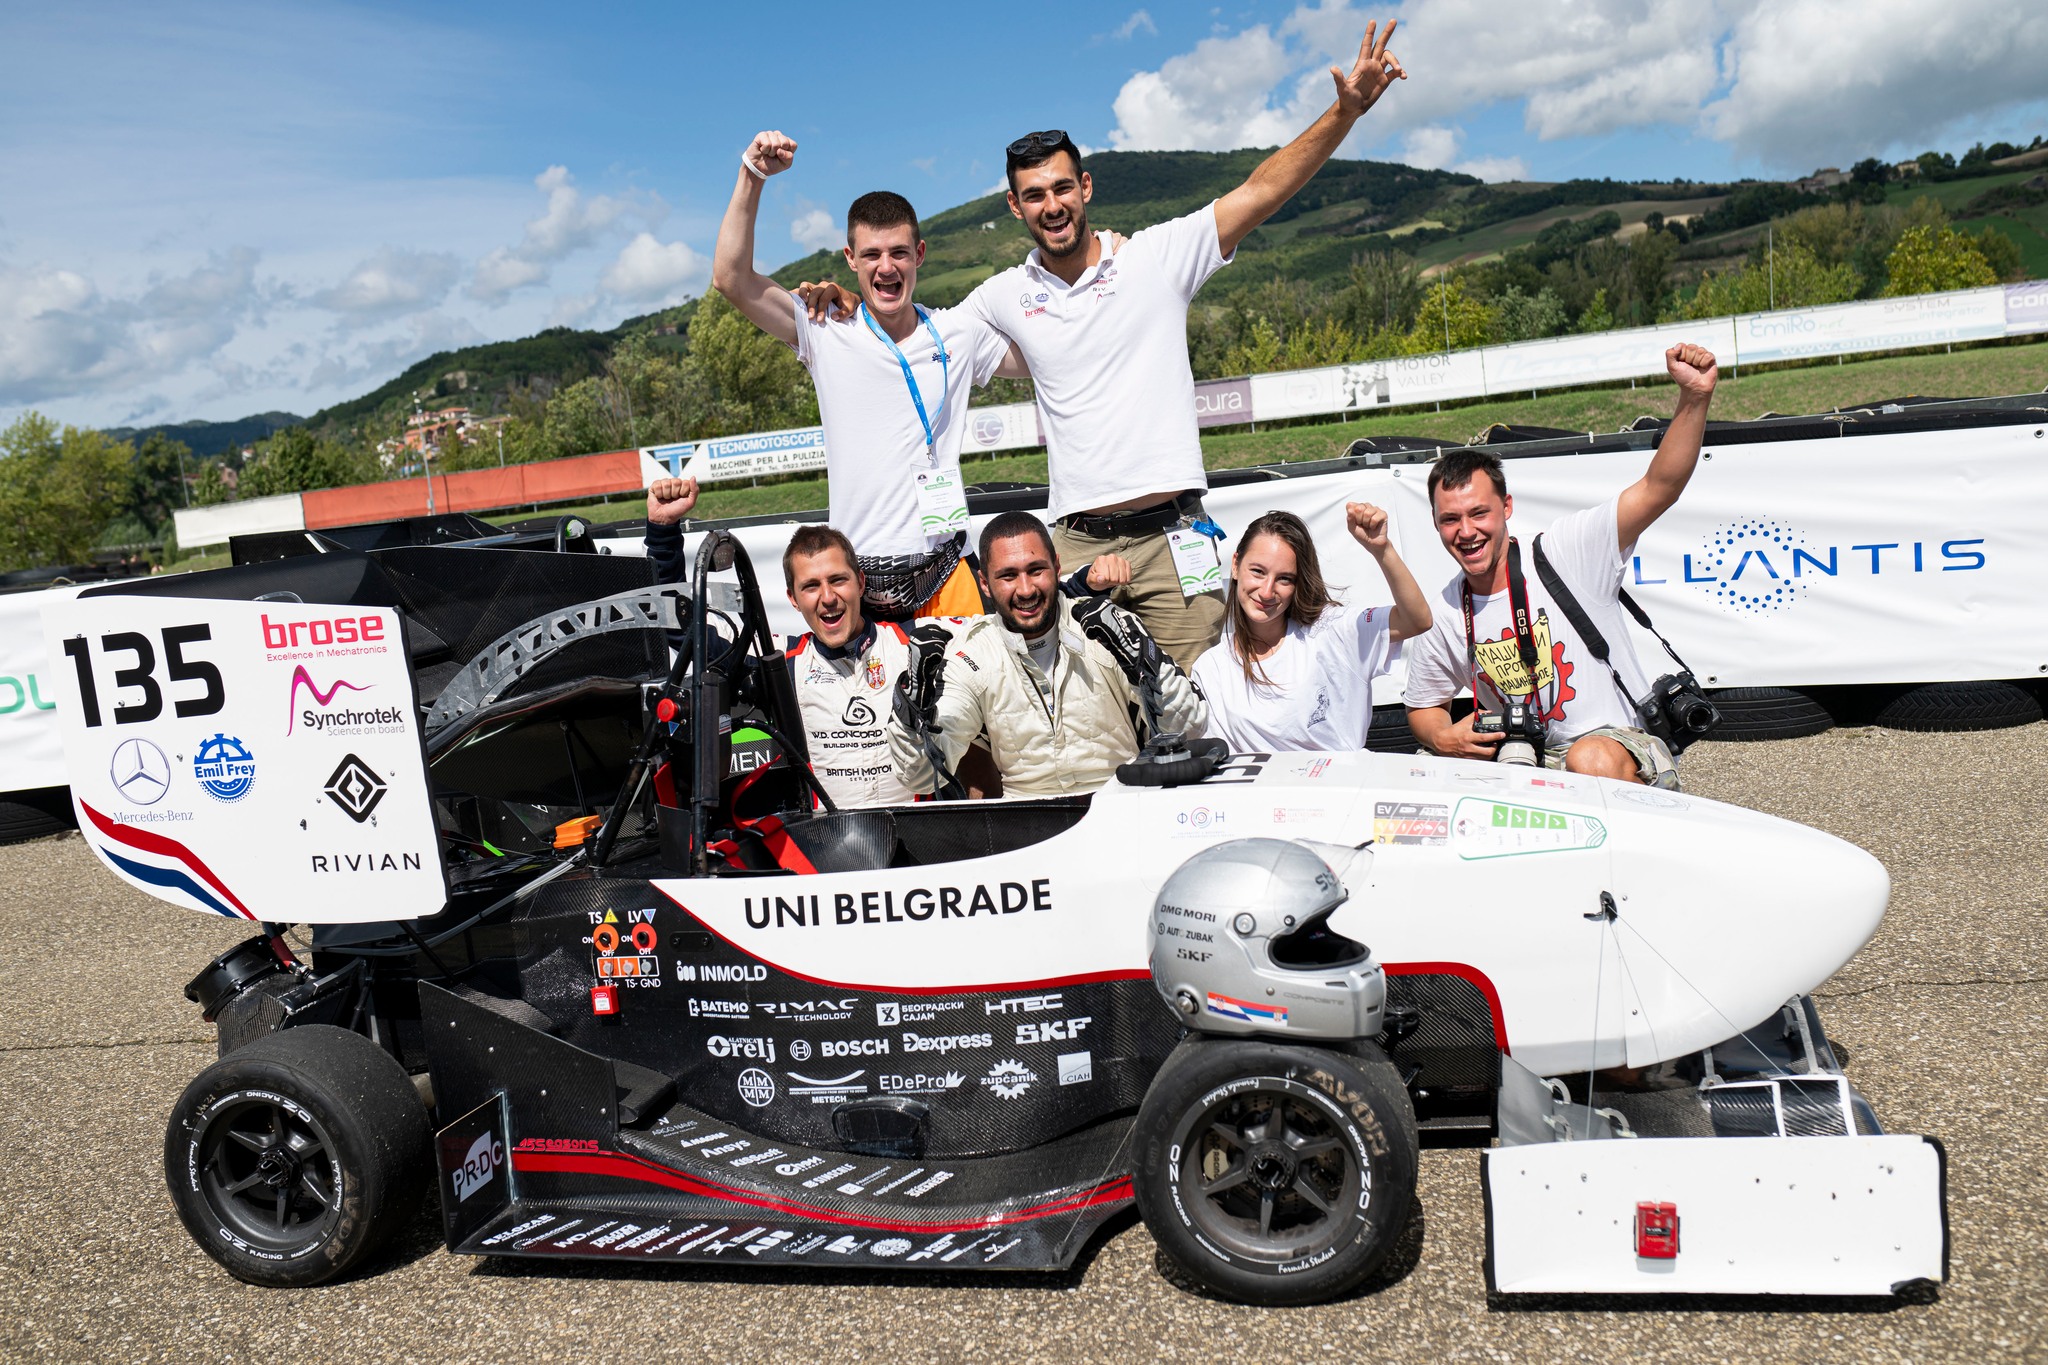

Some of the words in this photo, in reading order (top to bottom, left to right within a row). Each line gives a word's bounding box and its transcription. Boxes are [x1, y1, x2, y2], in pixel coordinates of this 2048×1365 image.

[1395, 354, 1451, 372] MOTOR
[1398, 373, 1446, 388] VALLEY
[1194, 391, 1242, 413] cura
[709, 431, 824, 458] TECNOMOTOSCOPE
[710, 459, 753, 471] MACCHINE
[756, 456, 773, 465] PER
[777, 454, 788, 463] LA
[792, 450, 826, 461] PULIZIA
[1632, 538, 1986, 585] LLANTIS
[1516, 608, 1528, 635] EOS
[261, 613, 385, 649] brose
[267, 651, 314, 663] Excellence
[316, 649, 325, 659] in
[327, 645, 388, 658] Mechatronics
[63, 622, 226, 728] 135
[303, 706, 404, 731] Synchrotek
[327, 725, 362, 736] Science
[364, 726, 376, 736] on
[377, 723, 405, 735] board
[831, 729, 883, 739] CONCORD
[861, 739, 888, 749] COMPA
[195, 764, 224, 780] Emil
[226, 761, 256, 780] Frey
[826, 767, 860, 777] BRITISH
[113, 809, 195, 825] Mercedes-Benz
[1377, 805, 1393, 815] EV
[311, 853, 422, 873] RIVIAN
[744, 897, 820, 929] UNI
[835, 878, 1053, 925] BELGRADE
[588, 911, 604, 925] TS
[627, 910, 643, 924] LV
[1160, 904, 1182, 916] DMG
[1183, 909, 1217, 923] MORI
[582, 936, 594, 944] ON
[621, 935, 633, 943] ON
[1186, 930, 1214, 944] ZUBAK
[1177, 948, 1214, 963] SKF
[700, 965, 768, 982] INMOLD
[640, 978, 662, 988] GND
[700, 1000, 749, 1014] BATEMO
[755, 998, 859, 1014] RIMAC
[901, 1001, 965, 1013] БЕОГРАДСКИ
[985, 993, 1064, 1016] HTEC
[793, 1012, 852, 1022] TECHNOLOGY
[902, 1012, 935, 1022] САЈАМ
[1015, 1016, 1093, 1045] SKF
[821, 1038, 890, 1057] BOSCH
[902, 1032, 993, 1055] Dexpress
[879, 1073, 946, 1091] EDePro
[980, 1071, 1039, 1086] zupčanik
[1066, 1072, 1091, 1084] CIAH
[246, 1091, 280, 1102] RACING
[811, 1095, 847, 1104] METECH
[1347, 1124, 1370, 1167] RACING
[1171, 1186, 1192, 1227] RACING
[249, 1249, 283, 1260] RACING
[1278, 1259, 1310, 1274] Formula
[1310, 1247, 1336, 1268] Student
